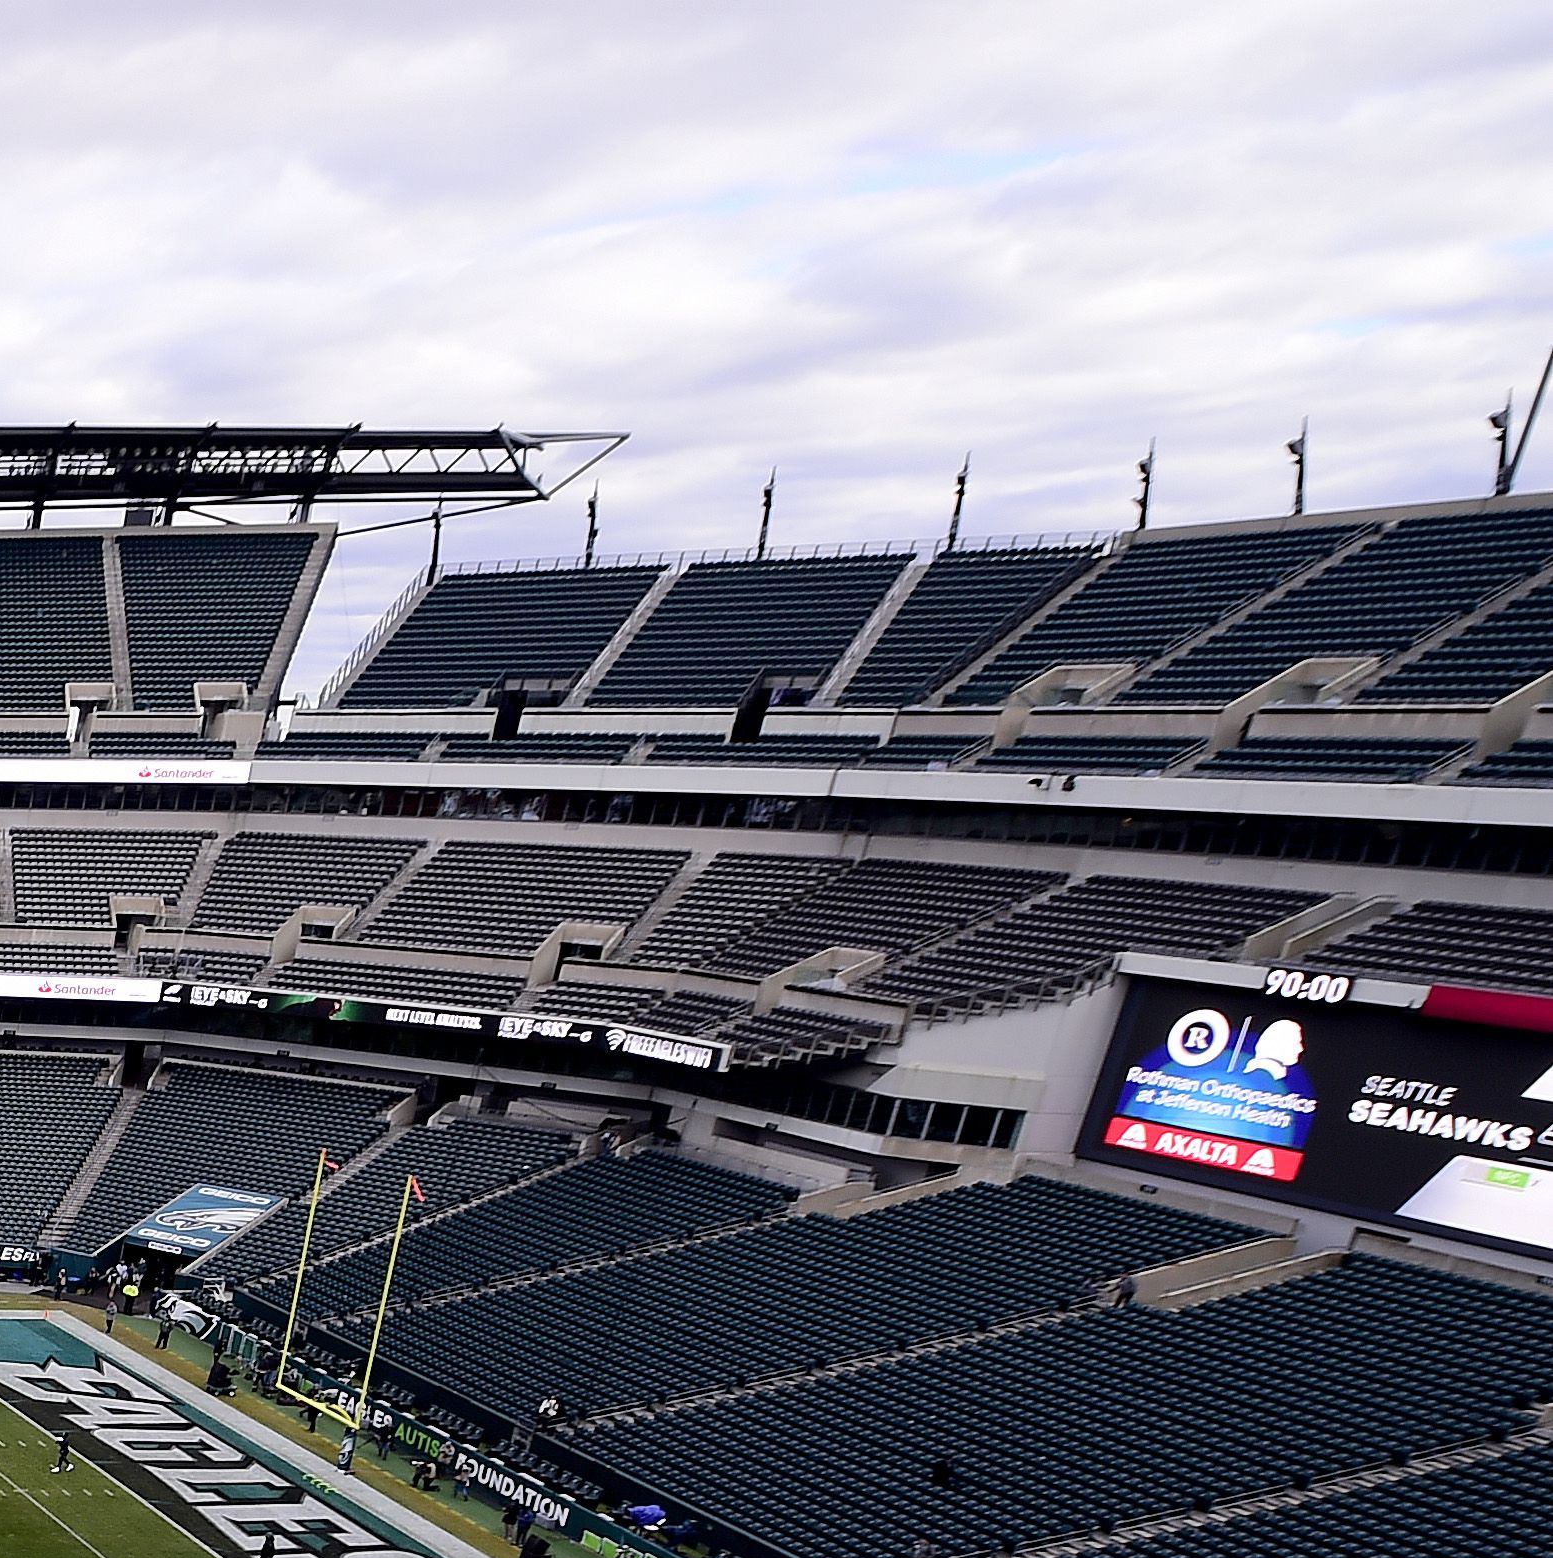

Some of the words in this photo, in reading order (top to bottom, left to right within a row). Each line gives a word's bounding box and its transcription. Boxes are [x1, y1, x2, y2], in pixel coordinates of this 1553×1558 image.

[153, 767, 214, 780] Santander
[53, 983, 116, 996] Santander
[1265, 969, 1349, 1004] 90:00
[1184, 1026, 1210, 1050] R
[1126, 1066, 1201, 1093] Rothman
[1201, 1079, 1318, 1114] Orthopaedics
[1360, 1075, 1459, 1107] SEATTLE
[1135, 1088, 1158, 1104] at
[1157, 1090, 1232, 1117] Jefferson
[1232, 1103, 1293, 1129] Health
[1348, 1099, 1534, 1151] SEAHAWKS
[1154, 1132, 1239, 1167] AXALTA
[198, 1187, 272, 1205] GEICO
[137, 1228, 211, 1248] GEICO
[454, 1452, 571, 1527] FOUNDATION
